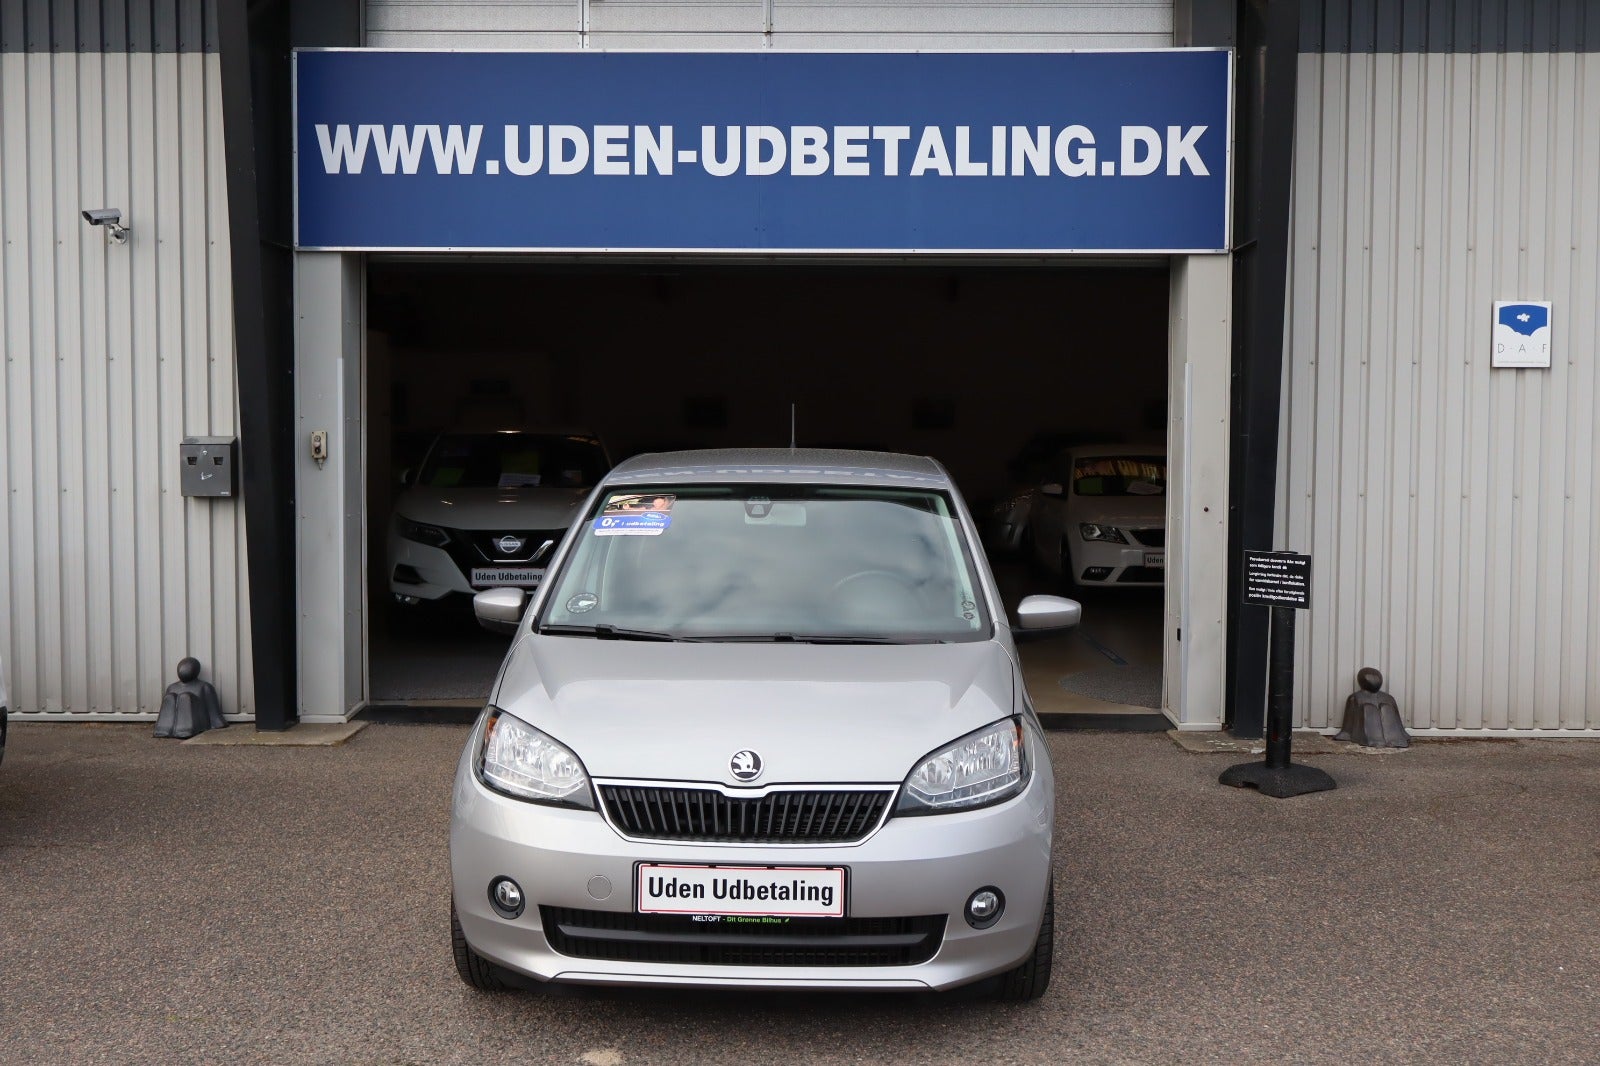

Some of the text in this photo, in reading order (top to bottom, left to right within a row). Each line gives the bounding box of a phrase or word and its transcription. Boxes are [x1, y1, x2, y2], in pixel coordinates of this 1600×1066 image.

[315, 123, 1210, 178] WWW.UDEN-UDBETALING.DK
[475, 572, 543, 582] Uden Udbetaling
[648, 876, 833, 907] Uden Udbetaling
